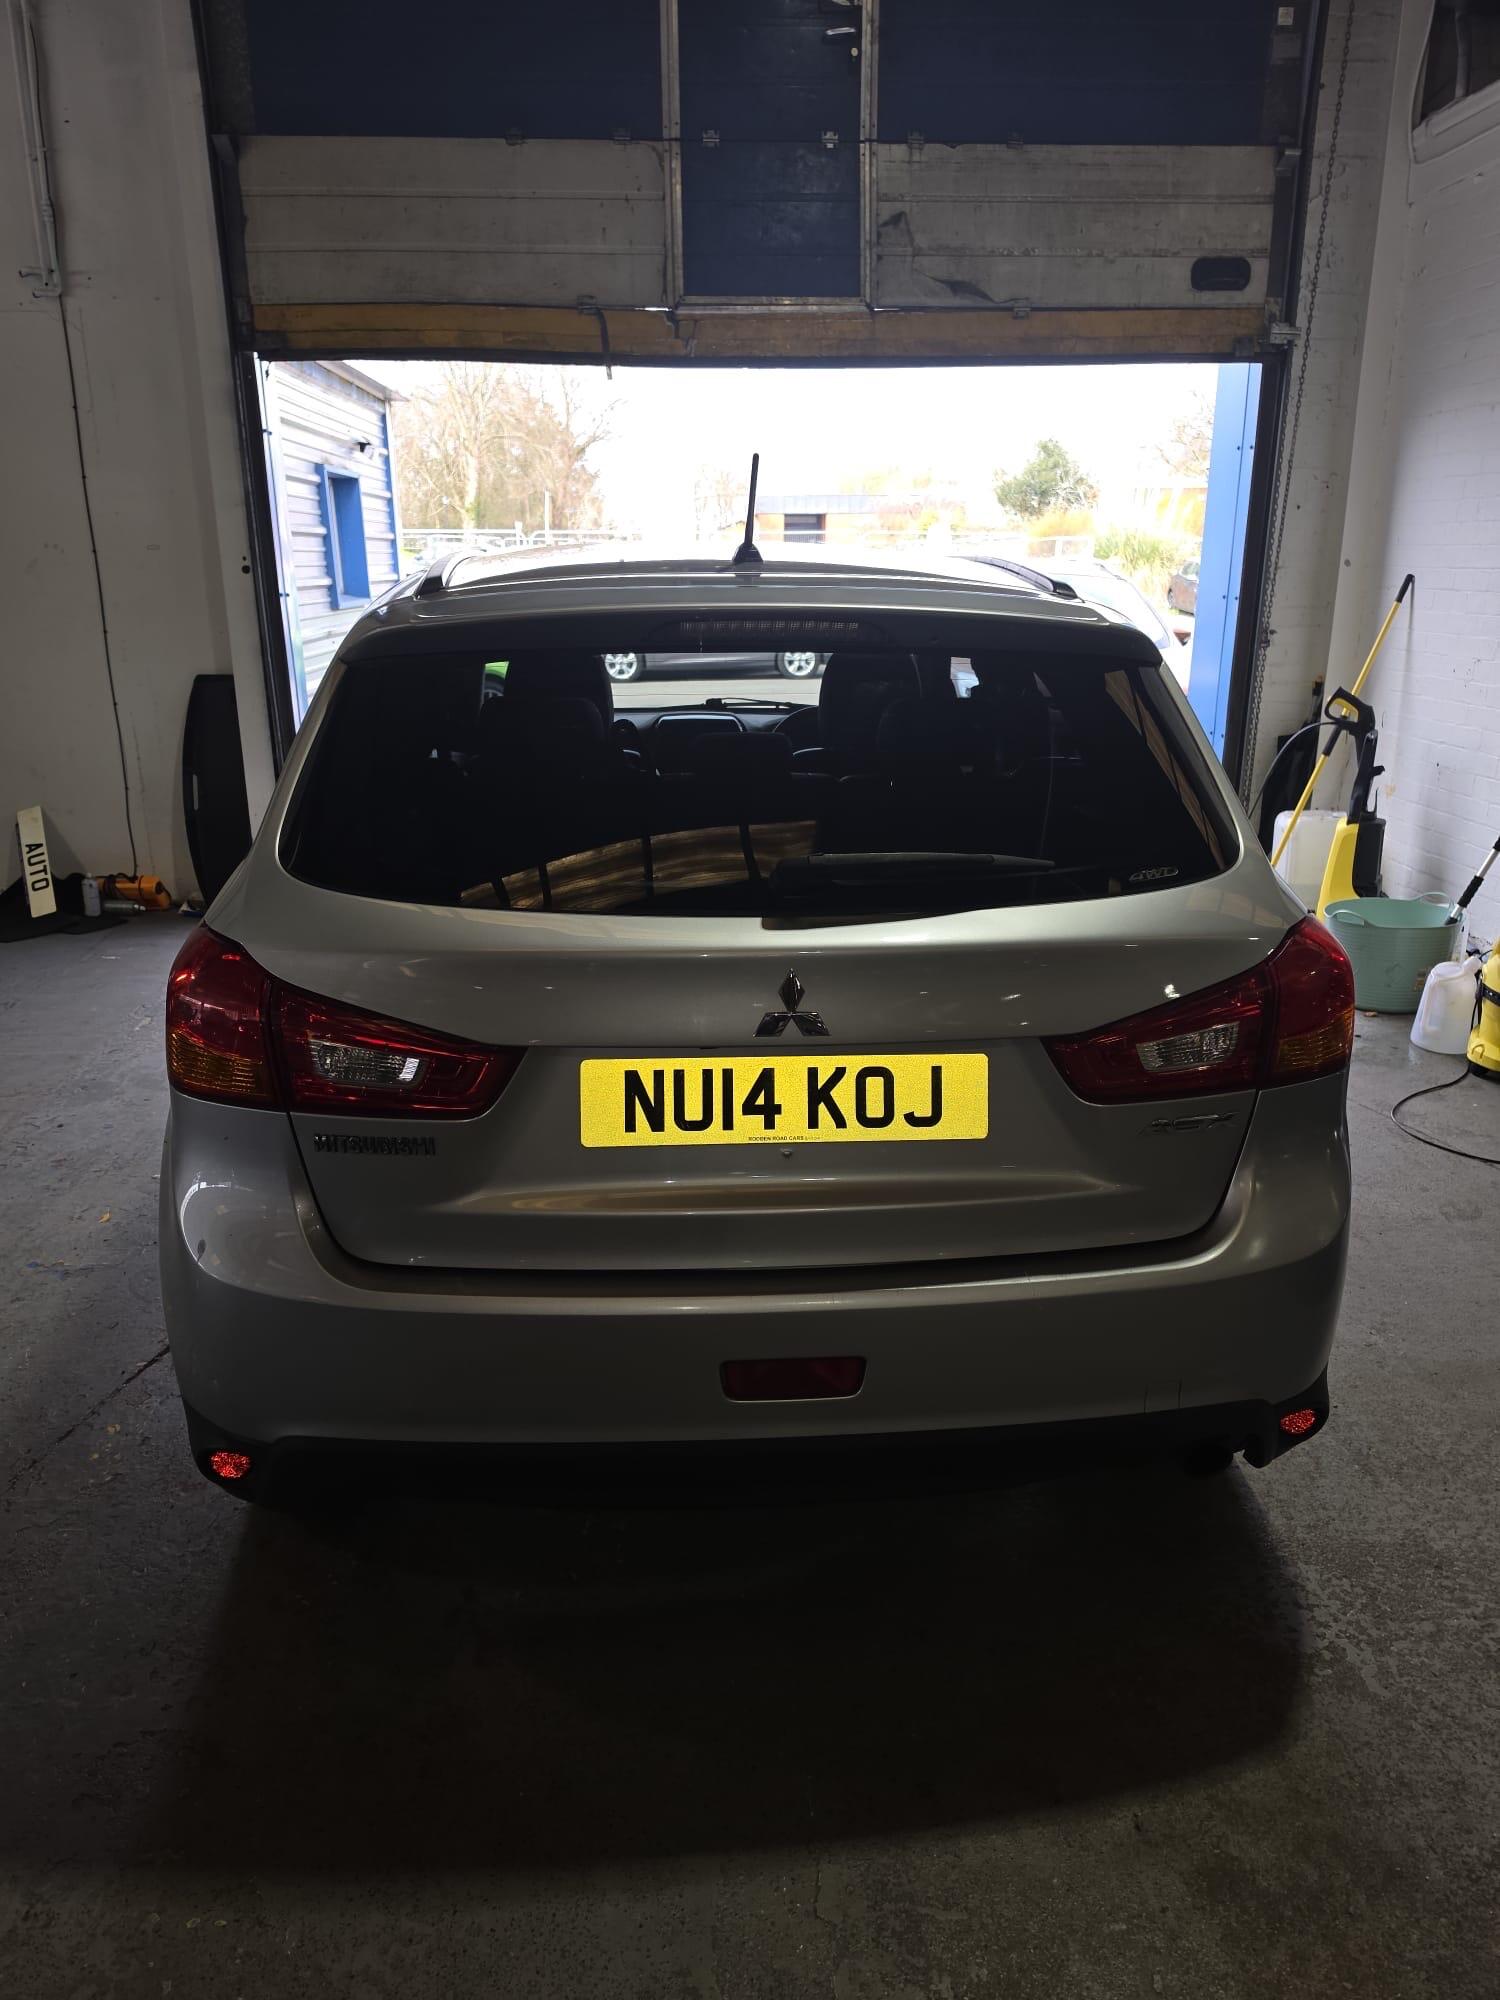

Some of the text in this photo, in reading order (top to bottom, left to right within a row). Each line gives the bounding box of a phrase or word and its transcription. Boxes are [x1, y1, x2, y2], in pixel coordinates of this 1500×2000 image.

[25, 843, 50, 892] AUTO
[624, 1065, 943, 1133] NU14 KOJ
[313, 1134, 437, 1156] MITSUBISHI
